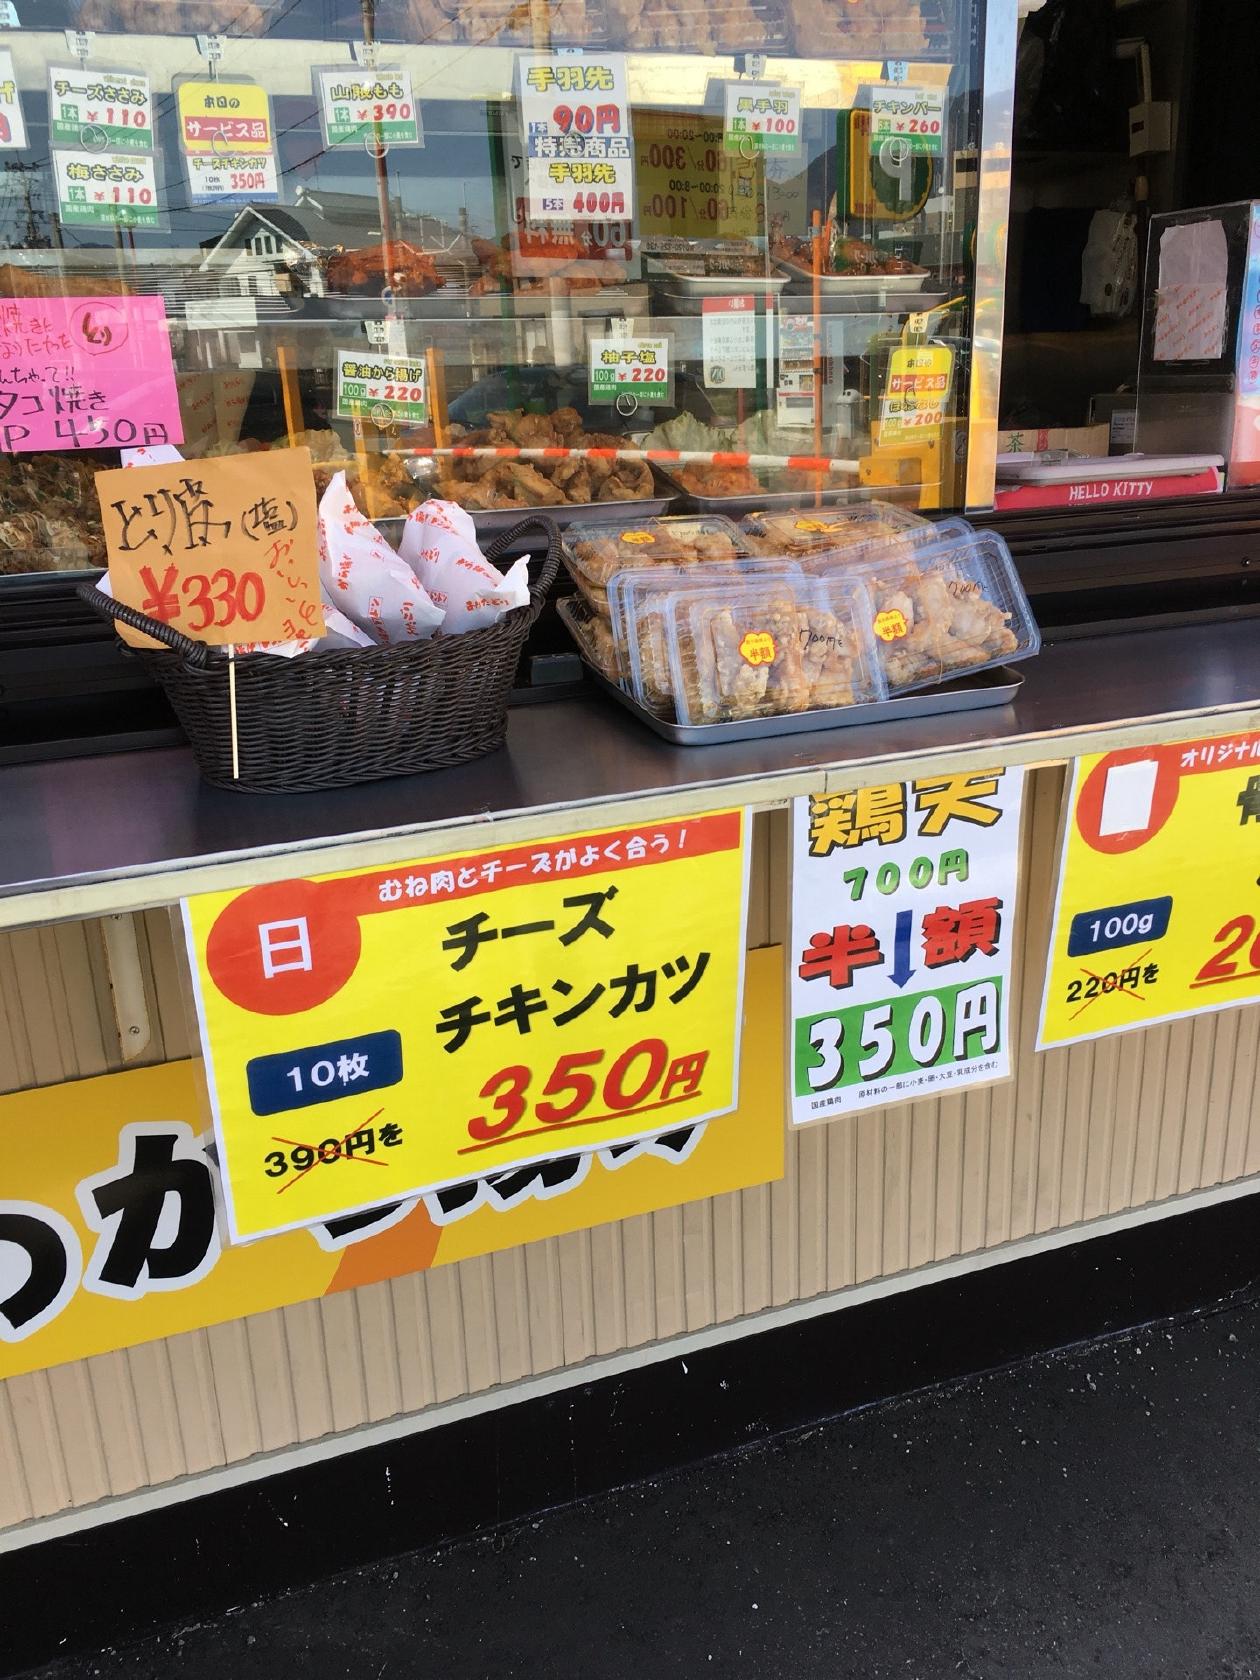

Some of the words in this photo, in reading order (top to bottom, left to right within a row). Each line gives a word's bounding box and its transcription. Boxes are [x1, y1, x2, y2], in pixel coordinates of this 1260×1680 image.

[528, 66, 614, 92] 手羽先
[54, 80, 148, 105] チーズささみ
[203, 95, 240, 109] 本日の
[329, 82, 404, 102] 山賊もも
[61, 104, 79, 121] 1本
[334, 107, 351, 122] 1本
[529, 122, 548, 135] 1本
[553, 103, 620, 135] 90円
[873, 100, 941, 116] チキンバー
[187, 121, 266, 139] サービス品
[67, 162, 144, 182] 梅ささみ
[230, 173, 265, 190] 350円
[549, 163, 616, 184] 手羽先
[68, 186, 86, 201] 1本
[543, 198, 563, 210] 5本
[573, 192, 624, 213] 400円
[601, 349, 656, 365] 柚子塩
[342, 361, 422, 383] 醤油から揚げ
[891, 375, 946, 390] サービス品
[55, 415, 168, 448] 450円
[1069, 482, 1109, 500] HELLO
[1113, 481, 1153, 497] KITTY
[139, 563, 266, 632] ¥330
[882, 623, 904, 637] 半額
[750, 647, 772, 662] 半額
[809, 766, 1006, 857] 鶏天
[378, 829, 689, 901] むね肉とチーズがよく合う!
[843, 848, 970, 901] 700円
[442, 884, 619, 972] チーズ
[1089, 913, 1155, 943] 100g
[258, 916, 313, 979] 日
[1066, 962, 1160, 1004] 220円を
[435, 952, 711, 1054] チキンカツ
[807, 980, 1001, 1092] 350円
[287, 1052, 370, 1092] 10枚
[467, 1037, 709, 1142] 350円
[811, 1095, 843, 1110] 国産鶏肉
[264, 1122, 403, 1178] 390円を
